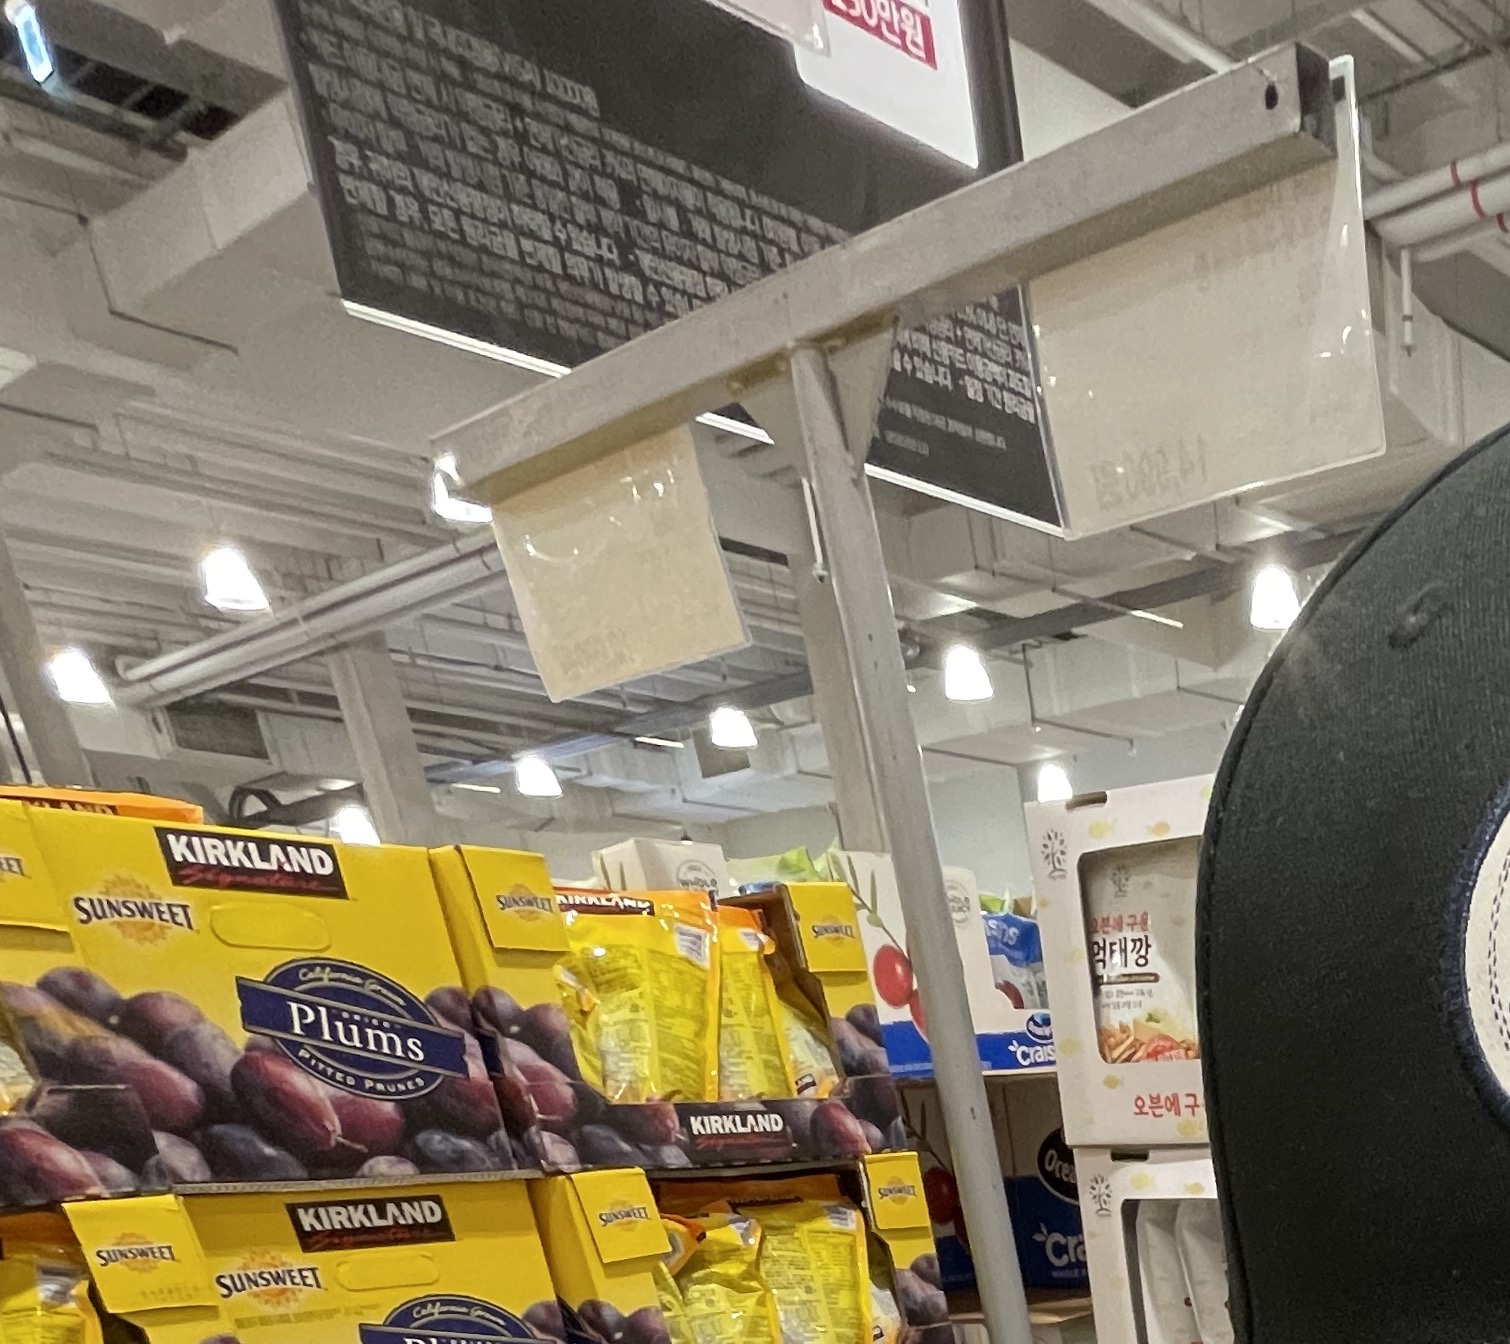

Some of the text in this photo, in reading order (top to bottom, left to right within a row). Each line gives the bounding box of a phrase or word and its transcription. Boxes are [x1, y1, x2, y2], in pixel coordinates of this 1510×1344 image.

[167, 833, 334, 877] KIRKLAND
[73, 896, 194, 931] SUNSWEET
[496, 894, 556, 914] SUNSWEET
[287, 1001, 426, 1063] Plums
[298, 1049, 427, 1096] PITTED PRUNES
[1134, 1093, 1201, 1118] 오븐에 구
[690, 1113, 784, 1136] KIRKLAND
[298, 1201, 443, 1233] KIRKLAND
[96, 1244, 176, 1268] SUNSWEET
[215, 1266, 323, 1299] SUNSWEET
